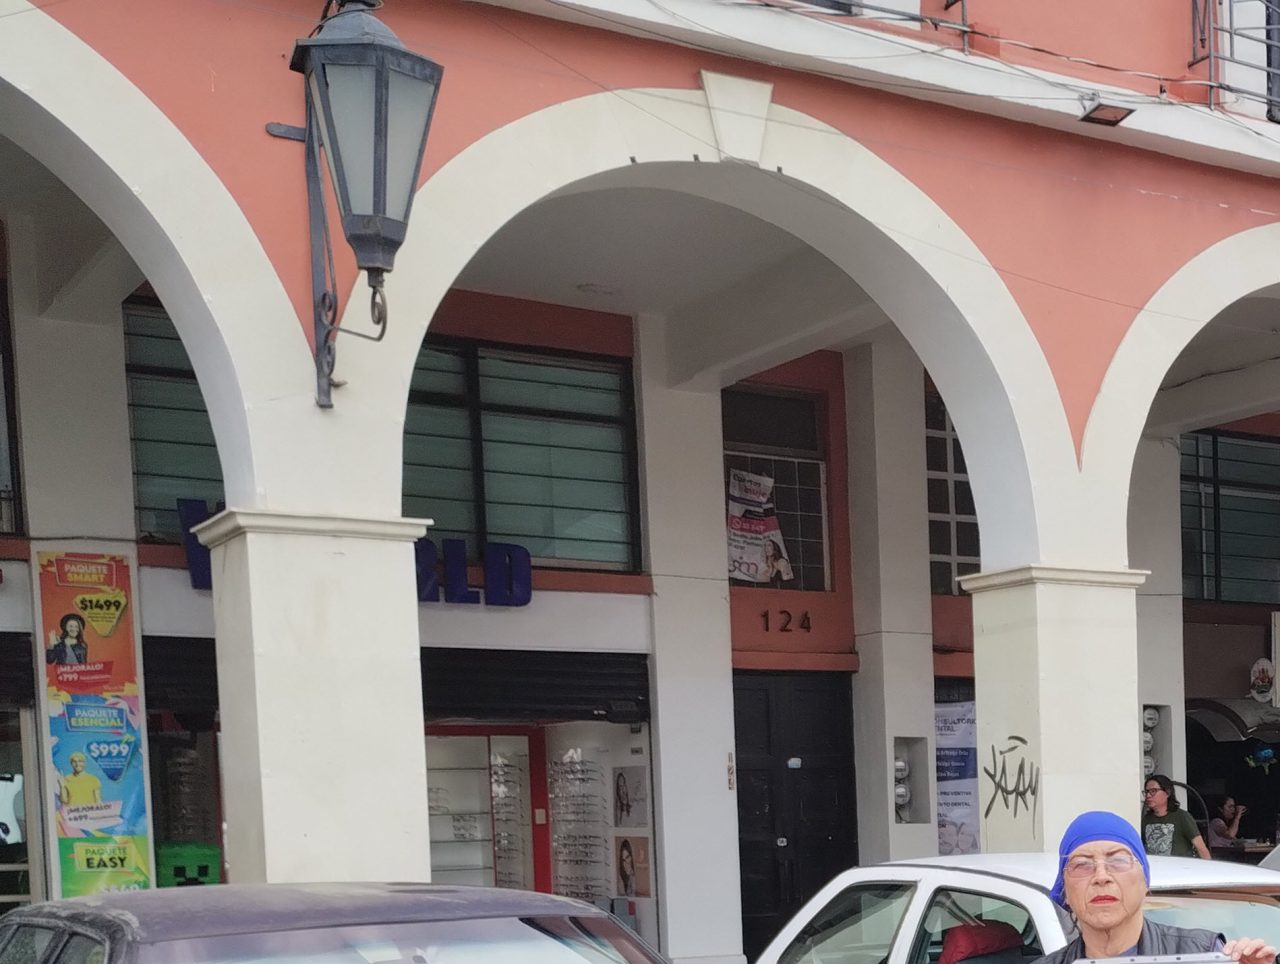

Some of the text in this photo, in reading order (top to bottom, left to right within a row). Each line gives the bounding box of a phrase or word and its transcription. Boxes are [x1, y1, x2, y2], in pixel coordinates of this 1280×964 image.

[64, 562, 108, 576] PAQUETE
[66, 572, 106, 583] SMART
[79, 598, 122, 612] $1499
[760, 609, 812, 632] 124
[74, 707, 119, 719] PAQUETE
[70, 717, 124, 728] ESENCIAL
[89, 743, 130, 758] $999
[85, 846, 128, 857] PAQUETE
[86, 856, 128, 870] EASY
